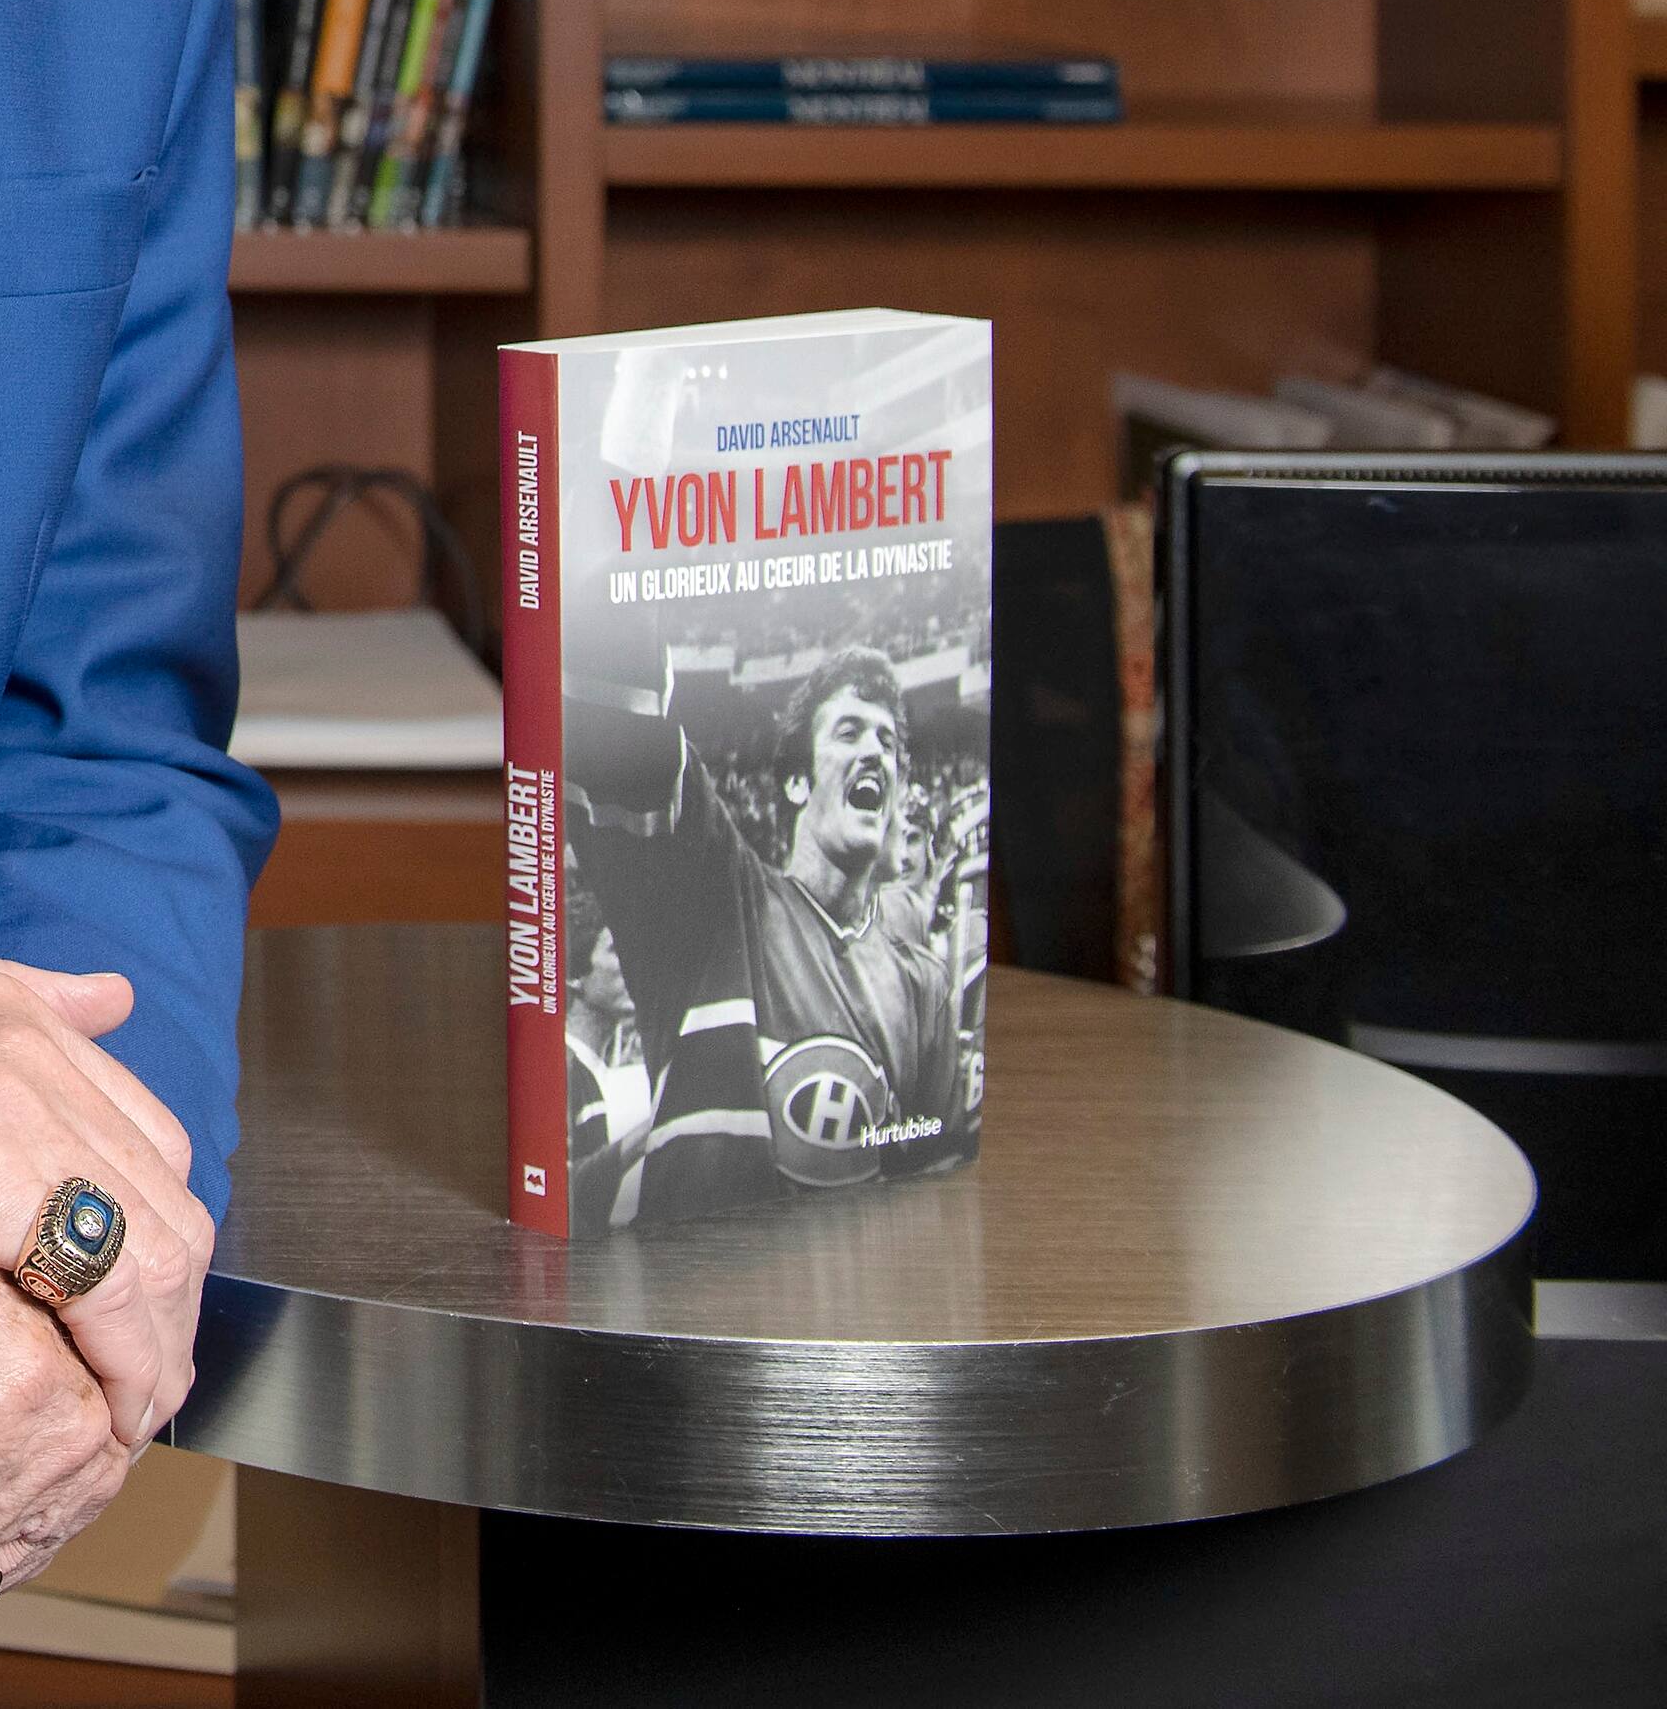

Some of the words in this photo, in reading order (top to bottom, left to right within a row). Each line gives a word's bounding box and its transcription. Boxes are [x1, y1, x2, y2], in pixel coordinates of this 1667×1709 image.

[717, 423, 765, 452] DAVID
[770, 415, 860, 447] ARSENAULT
[519, 431, 539, 546] ARSENAULT
[609, 470, 737, 552] YVON
[754, 450, 952, 540] LAMBERT
[520, 549, 540, 609] DAVID
[610, 571, 637, 603] UN
[641, 562, 731, 600] GLORIEUX
[735, 560, 760, 592] AU
[764, 554, 816, 589] CŒUR
[819, 551, 842, 583] DE
[846, 549, 868, 580] LA
[872, 539, 953, 578] DYNASTIE
[540, 770, 555, 832] DYNASTIE
[508, 761, 539, 916] LAMBERT
[541, 834, 555, 850] LA
[541, 852, 556, 870] DE
[542, 913, 556, 929] AU
[510, 920, 540, 1006] YVON
[542, 933, 557, 998] GLORIEUX
[543, 1000, 557, 1014] UN
[860, 1114, 943, 1148] Hurtubise
